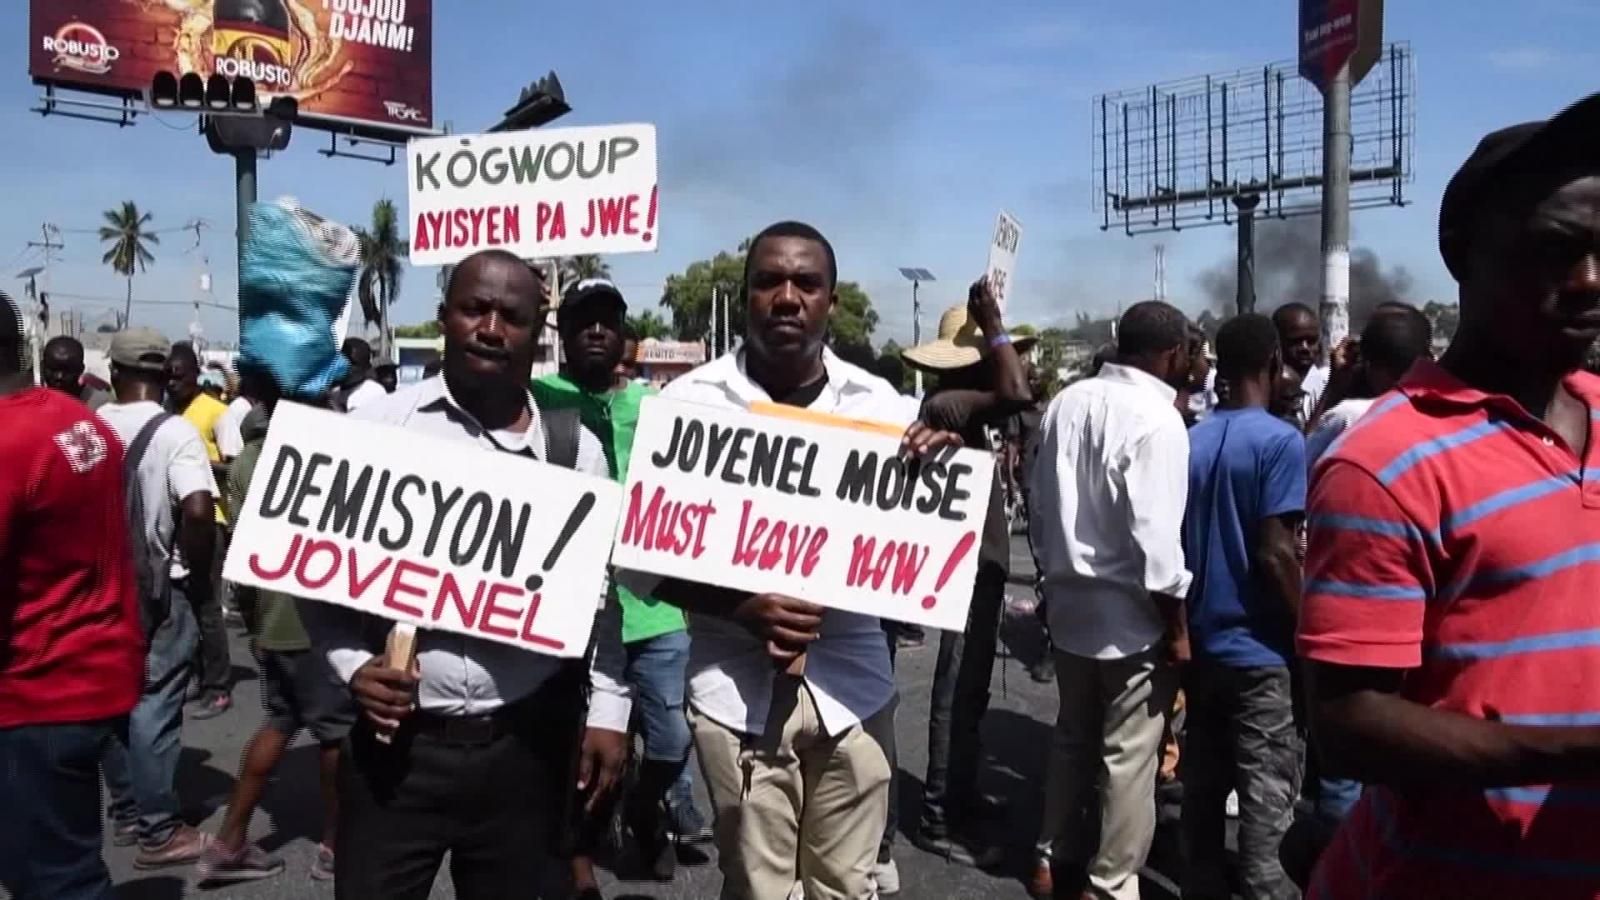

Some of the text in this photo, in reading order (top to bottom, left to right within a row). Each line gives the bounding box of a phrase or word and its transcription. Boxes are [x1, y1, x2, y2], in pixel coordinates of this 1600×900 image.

[43, 35, 120, 60] ROBUSTO
[329, 12, 414, 52] DJANM!
[216, 57, 291, 86] ROBUSTO
[414, 183, 658, 251] AYISYEN PA JWE!
[651, 416, 821, 498] JOVENEL
[621, 481, 716, 559] Must
[731, 500, 828, 578] leave
[249, 533, 565, 650] JOVENEL
